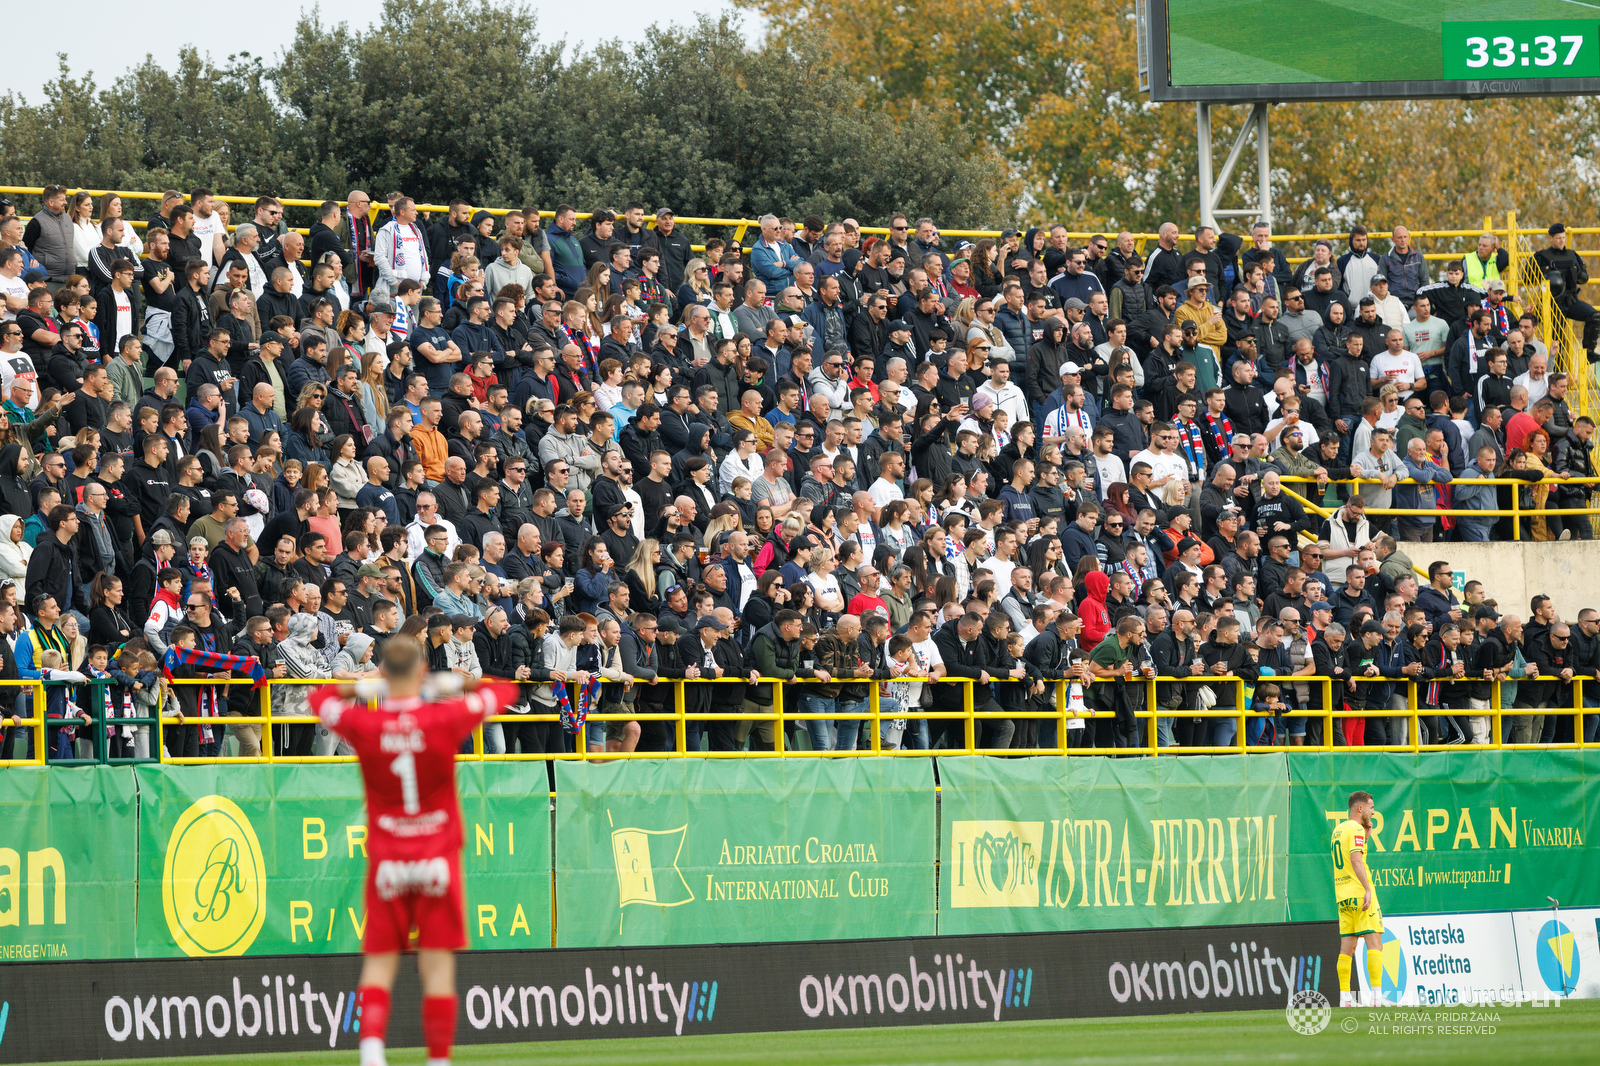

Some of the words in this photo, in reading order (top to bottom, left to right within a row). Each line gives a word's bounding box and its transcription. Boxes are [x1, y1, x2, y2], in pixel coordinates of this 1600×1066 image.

[1466, 36, 1583, 68] 33:37
[1482, 82, 1521, 92] ACTUM
[389, 752, 420, 815] 1
[303, 817, 514, 859] BRNI
[1522, 820, 1583, 848] VINARIJA
[718, 839, 800, 865] ADRIATIC
[805, 837, 878, 864] CROATIA
[1044, 815, 1278, 908] ISTRA-FERRUM
[706, 874, 839, 901] INTERNATIONAL
[848, 871, 889, 898] CLUB
[1424, 864, 1501, 889] www.trapan.hr
[290, 900, 530, 943] RIVRA
[1408, 923, 1465, 946] Istarska
[1413, 953, 1471, 976] Kreditna
[1417, 983, 1459, 1005] Banka
